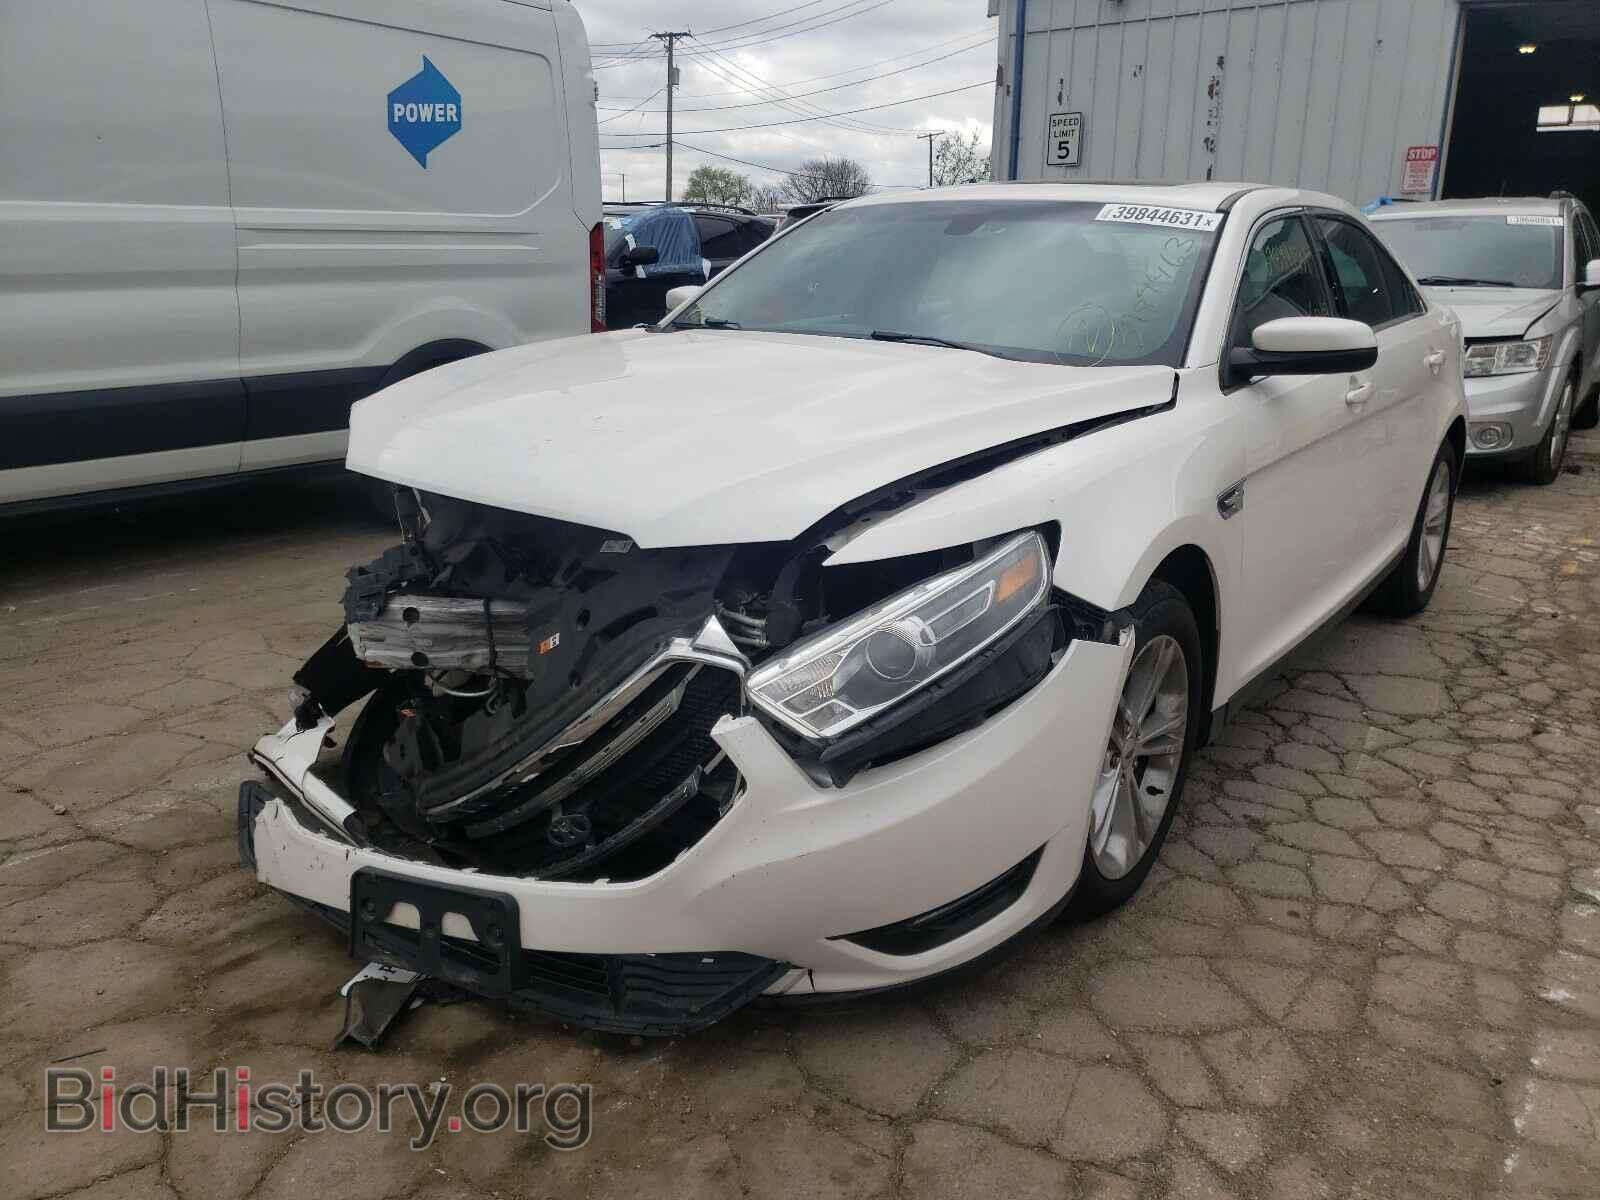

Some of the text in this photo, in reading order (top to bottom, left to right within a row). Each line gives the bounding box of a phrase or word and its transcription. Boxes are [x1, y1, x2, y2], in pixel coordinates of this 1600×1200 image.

[393, 103, 458, 123] POWER
[1052, 118, 1079, 127] SPEED
[1054, 129, 1075, 138] LIMIT
[1057, 141, 1070, 160] 5
[1408, 148, 1436, 160] STOP
